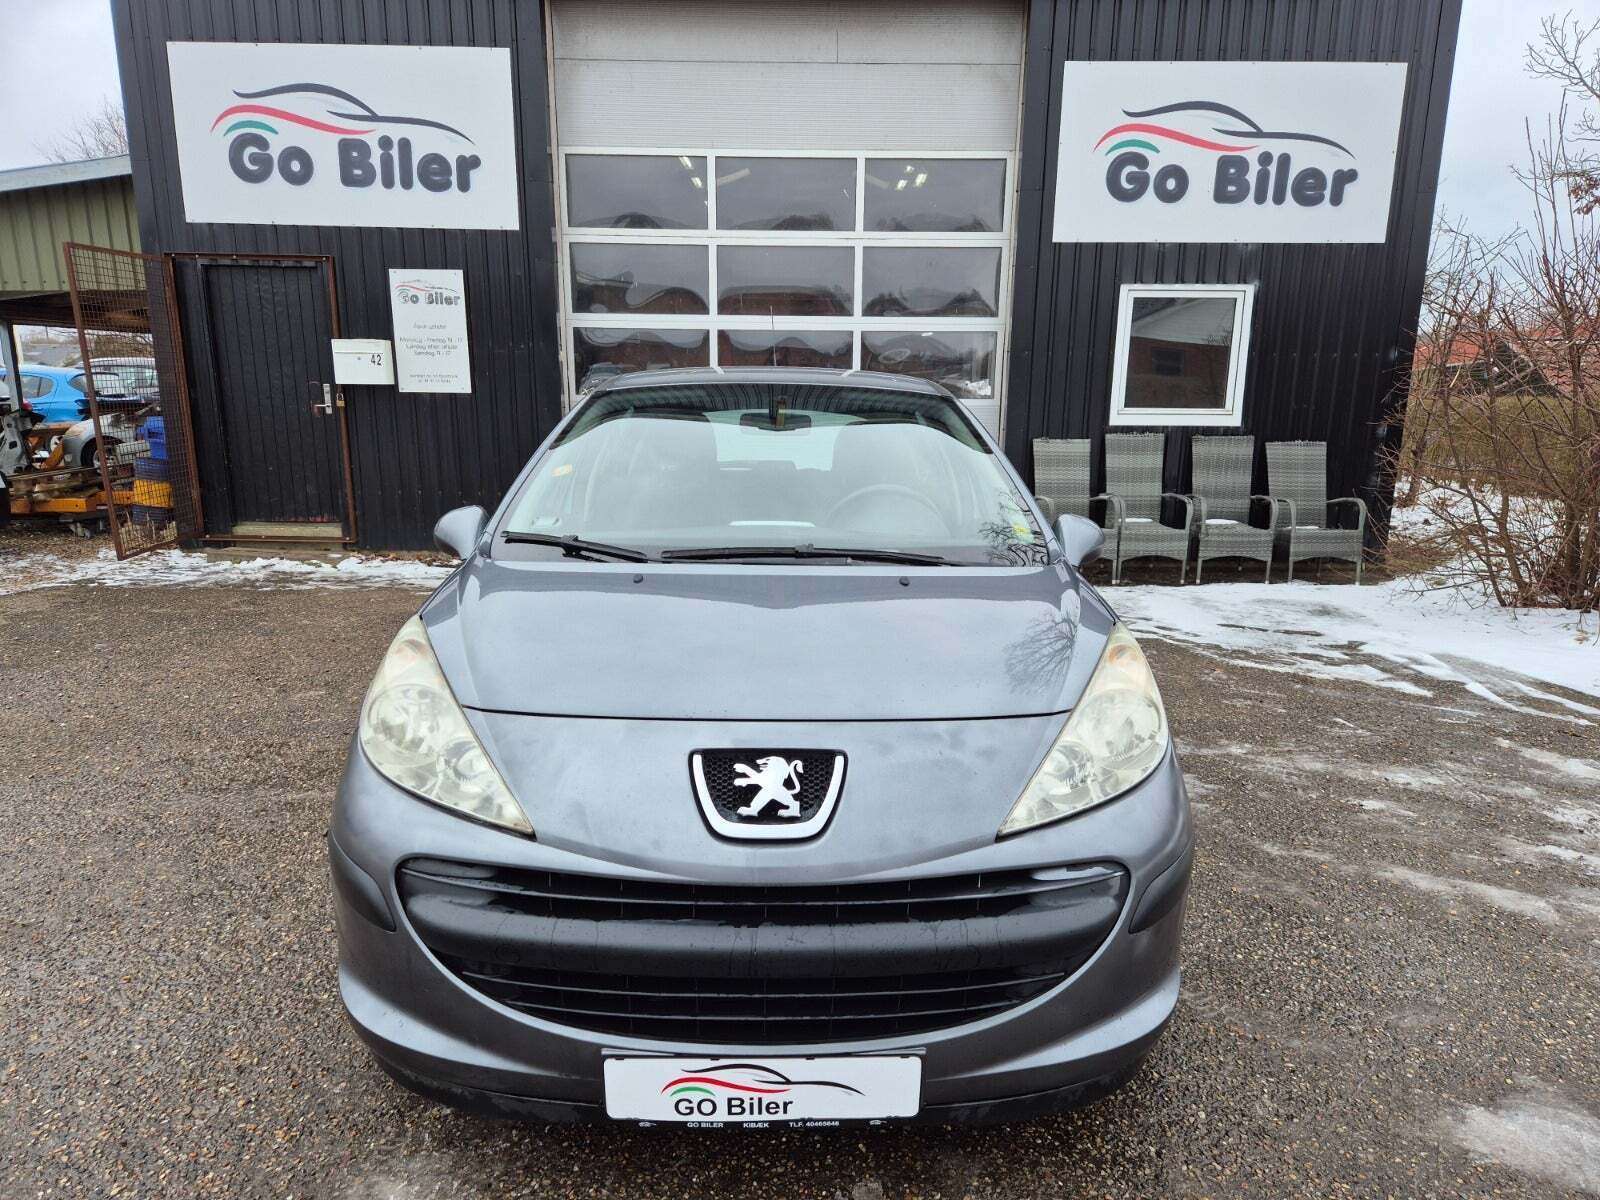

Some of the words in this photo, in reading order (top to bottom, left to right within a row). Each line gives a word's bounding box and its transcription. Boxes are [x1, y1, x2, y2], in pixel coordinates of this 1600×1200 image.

[228, 132, 315, 186] Go
[338, 135, 482, 193] Biler
[1105, 151, 1190, 204] Go
[1213, 150, 1359, 207] Biler
[399, 290, 420, 305] Go
[424, 291, 460, 306] Biler
[370, 354, 382, 366] 42
[674, 1097, 718, 1117] GO
[726, 1096, 794, 1116] Biler
